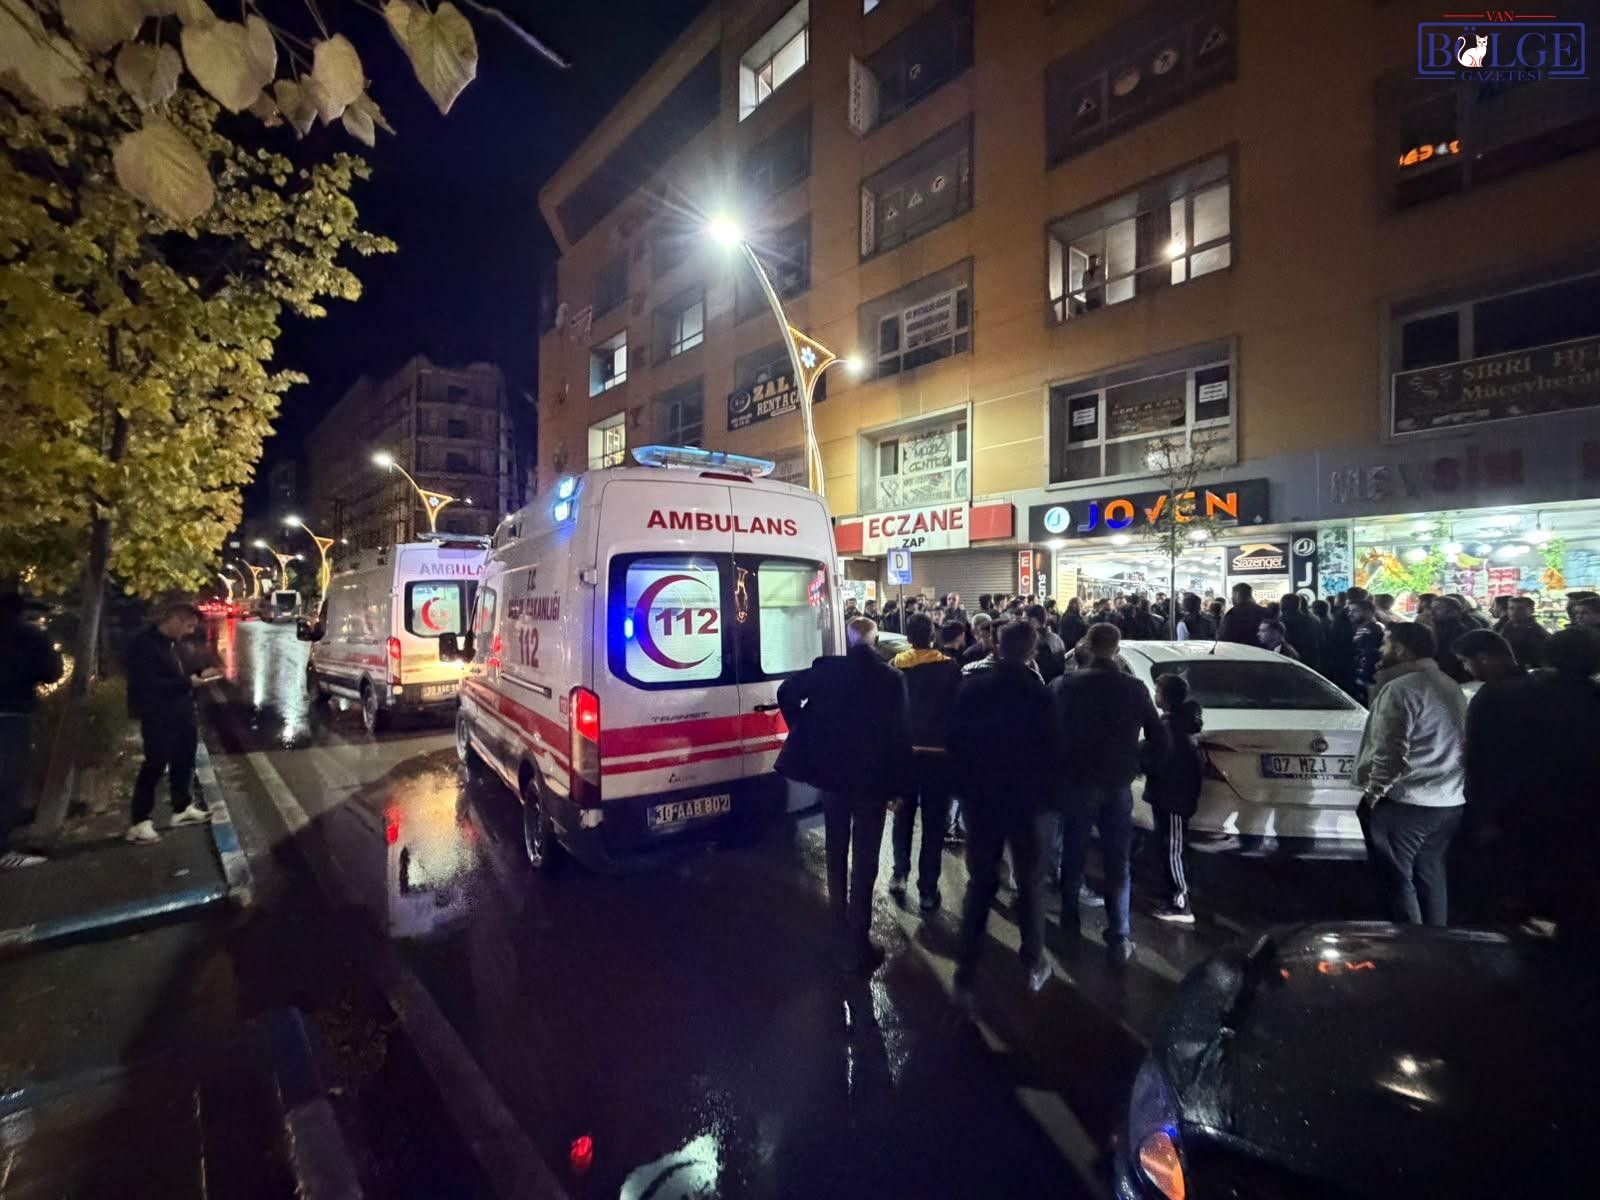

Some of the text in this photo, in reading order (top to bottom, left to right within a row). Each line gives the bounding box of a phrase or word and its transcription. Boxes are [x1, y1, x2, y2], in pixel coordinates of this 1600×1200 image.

[757, 396, 781, 416] RENT
[782, 393, 789, 407] A
[647, 509, 798, 536] AMBULANS
[869, 506, 963, 539] ECZANE
[1077, 490, 1239, 533] JOVEN
[902, 537, 925, 549] ZAP
[655, 607, 719, 636] 112
[519, 627, 539, 668] 112
[1273, 757, 1290, 773] 07
